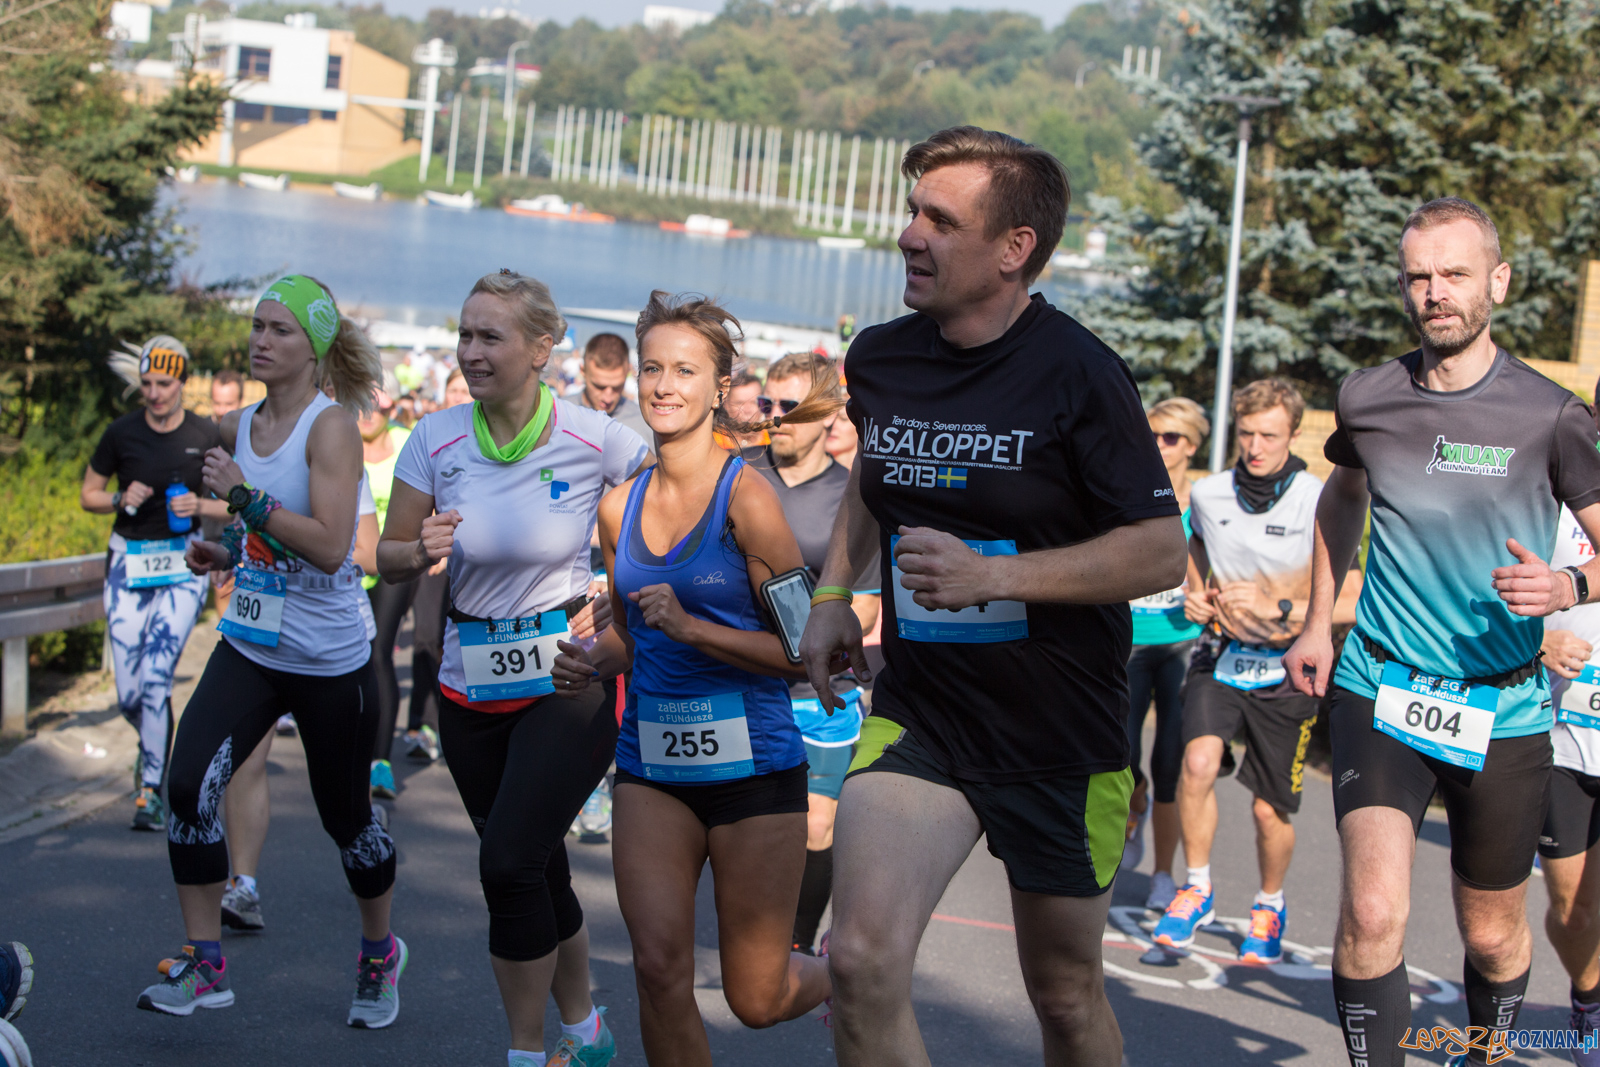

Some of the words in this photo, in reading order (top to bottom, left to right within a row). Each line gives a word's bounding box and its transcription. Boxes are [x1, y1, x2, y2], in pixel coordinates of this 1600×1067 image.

[892, 415, 906, 426] Ten
[906, 418, 930, 431] days.
[932, 420, 960, 431] Seven
[961, 423, 987, 432] races.
[863, 417, 1034, 465] VASALOPPET
[1441, 443, 1515, 468] MUAY
[883, 462, 937, 488] 2013
[1440, 462, 1479, 473] RUNNING
[1481, 466, 1507, 476] TEAM
[143, 556, 172, 572] 122
[237, 594, 261, 620] 690
[494, 630, 540, 642] FUNdusze
[490, 644, 542, 676] 391
[1234, 658, 1268, 676] 678
[1420, 684, 1468, 704] FUNdusze
[658, 700, 712, 713] zaBIEGaj
[666, 714, 714, 723] FUNdusze
[1405, 701, 1462, 738] 604
[662, 730, 719, 758] 255
